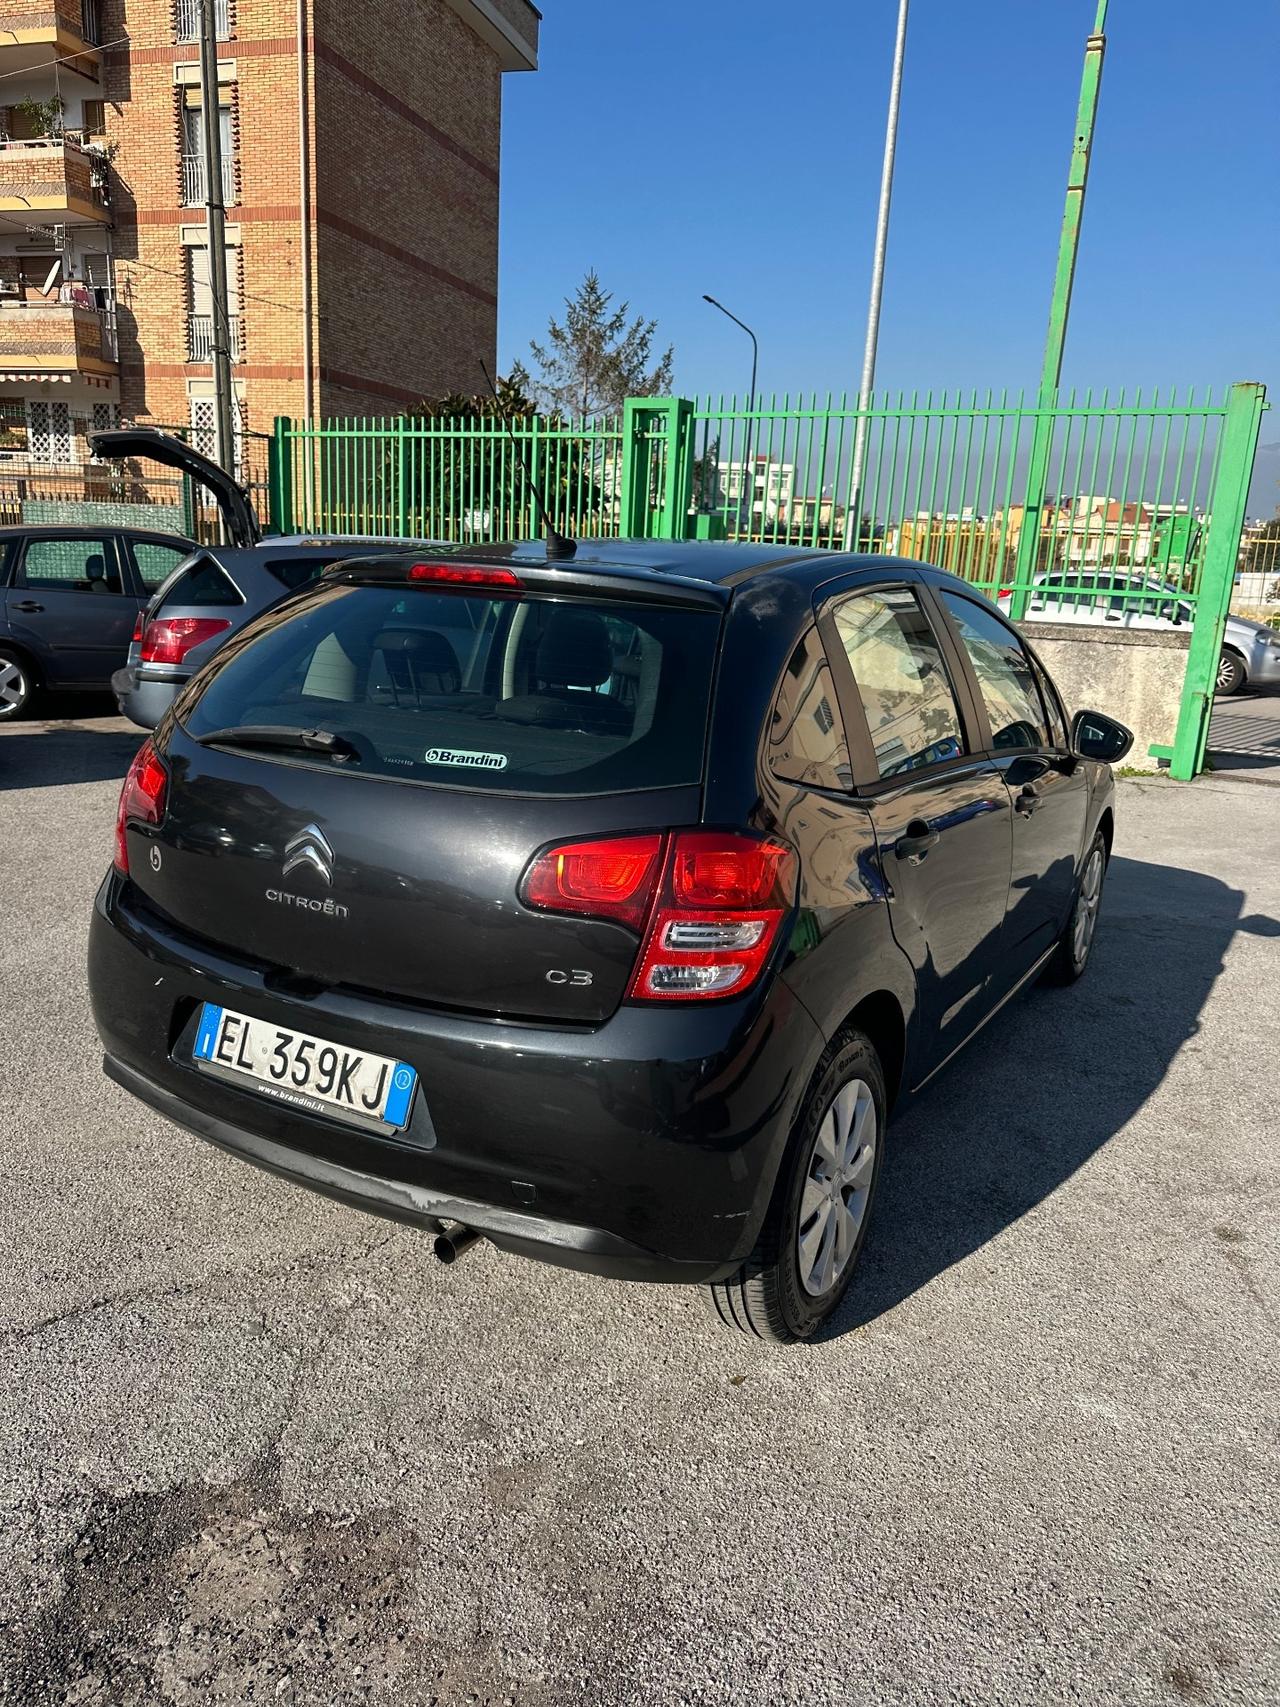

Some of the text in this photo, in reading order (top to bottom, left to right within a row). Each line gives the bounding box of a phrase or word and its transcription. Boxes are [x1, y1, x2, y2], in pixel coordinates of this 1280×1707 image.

[439, 751, 503, 767] Brandini
[545, 969, 593, 986] C3
[217, 1015, 389, 1110] EL 359KJ
[258, 1085, 325, 1112] www.brandini.it
